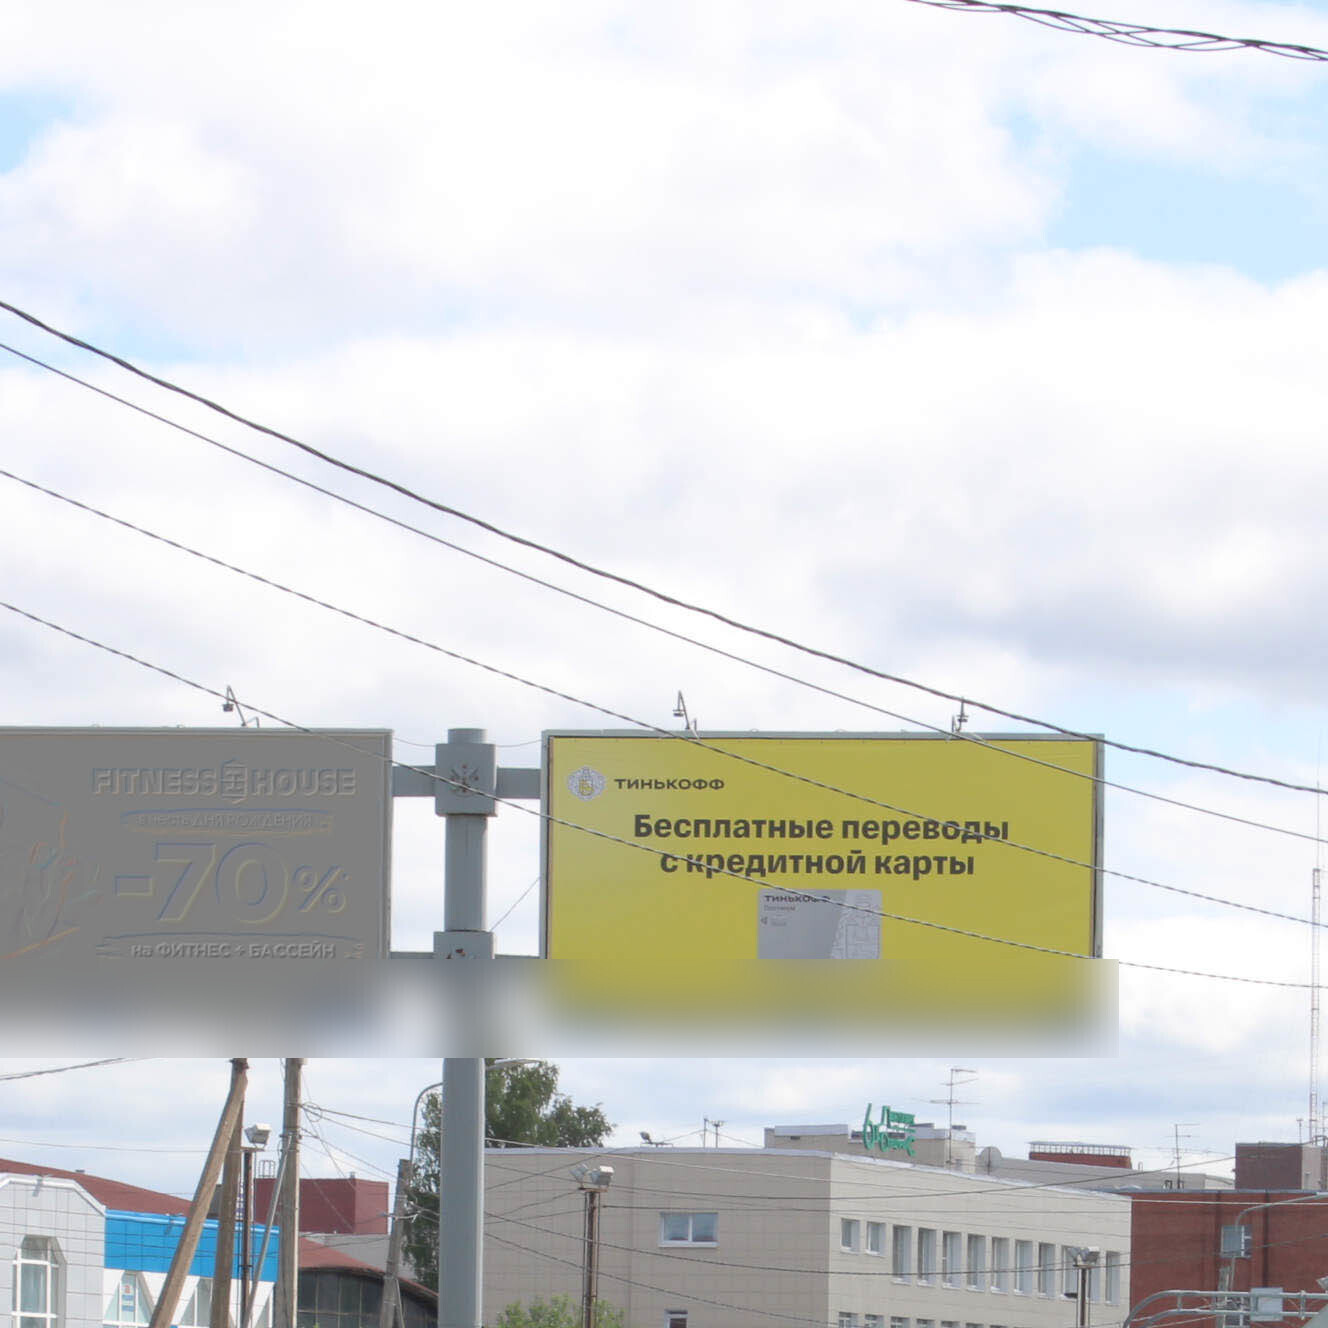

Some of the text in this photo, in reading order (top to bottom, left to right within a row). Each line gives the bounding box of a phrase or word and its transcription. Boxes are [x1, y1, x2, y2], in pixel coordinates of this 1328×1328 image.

[92, 767, 358, 797] FITNESS HOUSE
[614, 777, 725, 791] ТИНЬКОФФ
[634, 814, 1010, 845] Бесплатные переводы
[660, 849, 976, 880] с кредитной карты
[114, 841, 348, 925] -70%
[155, 942, 232, 959] ФИТНЕС
[248, 940, 337, 960] БАССЕЙН
